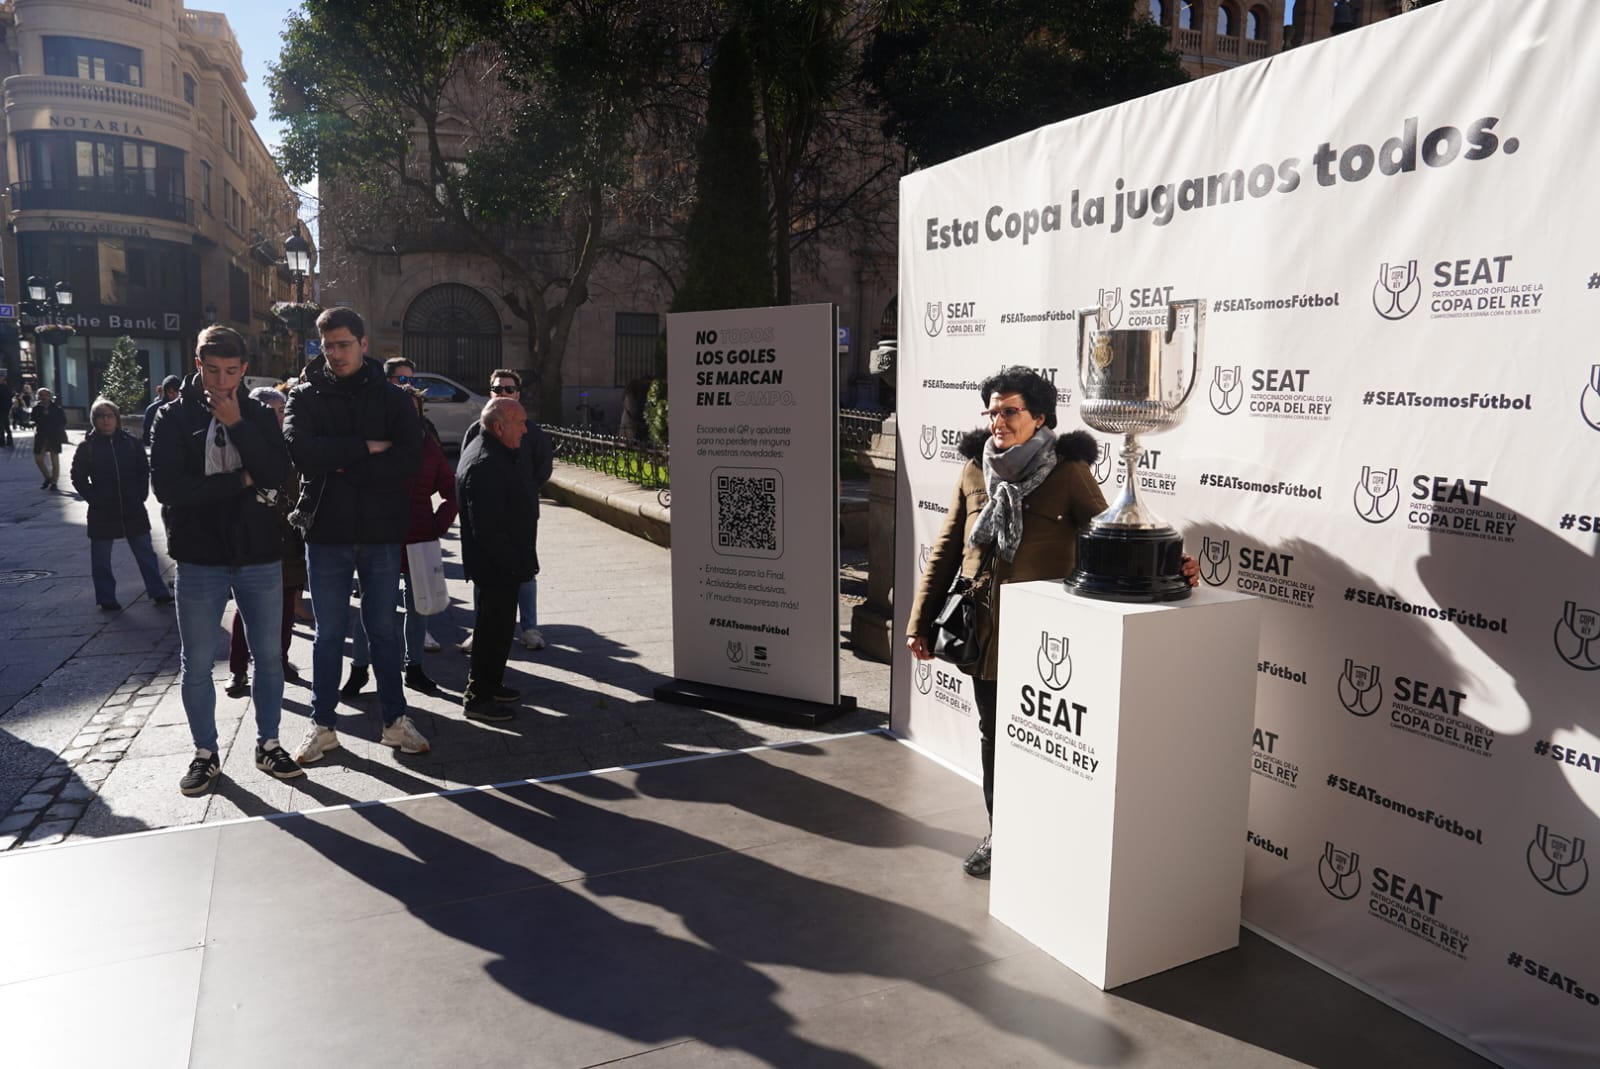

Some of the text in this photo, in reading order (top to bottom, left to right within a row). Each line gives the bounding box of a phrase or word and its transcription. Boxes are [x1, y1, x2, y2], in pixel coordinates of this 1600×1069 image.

[49, 115, 144, 136] NOTARÍA
[926, 116, 1520, 250] Esta Copa la jugamos todos.
[50, 221, 86, 232] ARCO
[1433, 255, 1513, 287] SEAT
[1130, 286, 1174, 308] SEAT
[1432, 283, 1544, 298] PATROCINADOR OFICIAL DE LA
[947, 301, 976, 319] SEAT
[1213, 292, 1340, 312] #SEATsomosFútbol
[1431, 293, 1542, 312] COPA DEL REY
[109, 314, 157, 330] Bank
[1000, 310, 1075, 324] #SEATsomosFútbol
[1128, 316, 1153, 326] COPA
[1154, 315, 1168, 325] DE
[696, 327, 775, 345] NO TODOS
[946, 324, 986, 333] COPA DEL REY
[696, 348, 776, 365] LOS GOLES
[696, 369, 783, 386] SE MARCAN
[922, 379, 984, 391] #SEATsomosFútbo
[1251, 369, 1310, 392] SEAT
[696, 391, 714, 406] EN
[717, 391, 732, 406] EL
[1249, 401, 1332, 415] COPA DEL REY
[1362, 391, 1532, 411] #SEATsomosFútbol
[696, 424, 727, 434] Escanea
[728, 425, 736, 434] el
[737, 425, 750, 435] QR
[756, 425, 791, 436] apúntate
[941, 429, 966, 446] SEA
[697, 437, 791, 448] para no perderte ninguna
[697, 448, 784, 458] de nuestras novedades:
[940, 450, 955, 460] COPA
[1141, 477, 1158, 489] DEL
[1159, 479, 1176, 491] REY
[1199, 473, 1322, 500] #SEATsomosFútbol
[1411, 474, 1488, 507] SEAT
[1410, 502, 1517, 522] PATROCINADOR OFICIAL DE LA
[1408, 511, 1516, 536] COPA DEL REY
[705, 563, 785, 581] Entradas para la Final.
[1239, 547, 1294, 577] SEAT
[705, 578, 787, 595] Actividades exclusivas.
[1237, 577, 1267, 594] COPA
[1269, 584, 1290, 599] DEL
[1292, 589, 1315, 603] REY
[1299, 582, 1307, 590] DE
[714, 593, 742, 603] muchas
[743, 597, 779, 608] sorpresas
[780, 600, 799, 610] más!
[1344, 587, 1508, 634] #SEATsomosFútbol
[709, 617, 790, 636] #SEATsomosFútbol
[1579, 614, 1596, 627] COPA
[936, 670, 963, 694] SEAT
[935, 690, 949, 702] COPA
[950, 697, 960, 709] DEL
[961, 703, 971, 714] REY
[1393, 676, 1467, 717] SEAT
[1020, 684, 1088, 737] SEAT
[1392, 702, 1495, 738] PATROCINADOR OFICIAL DE LA
[1011, 714, 1095, 755] PATROCINADOR OFICIAL DE LA
[1391, 710, 1430, 732] COPA
[1434, 723, 1460, 742] DEL
[1464, 732, 1494, 751] REY
[1007, 723, 1041, 750] COPA
[1045, 739, 1068, 762] DEL
[1072, 750, 1099, 774] REY
[1254, 758, 1273, 775] DEL
[1276, 766, 1298, 783] REY
[1326, 773, 1483, 845] #SEATsomosFútbol
[1246, 830, 1289, 861] Fútbol
[1372, 867, 1443, 916] SEAT
[1369, 899, 1407, 926] COPA
[1410, 917, 1436, 940] DEL
[1440, 931, 1468, 953] REY
[1370, 890, 1470, 942] PATROCINADOR OFICIAL DE LA
